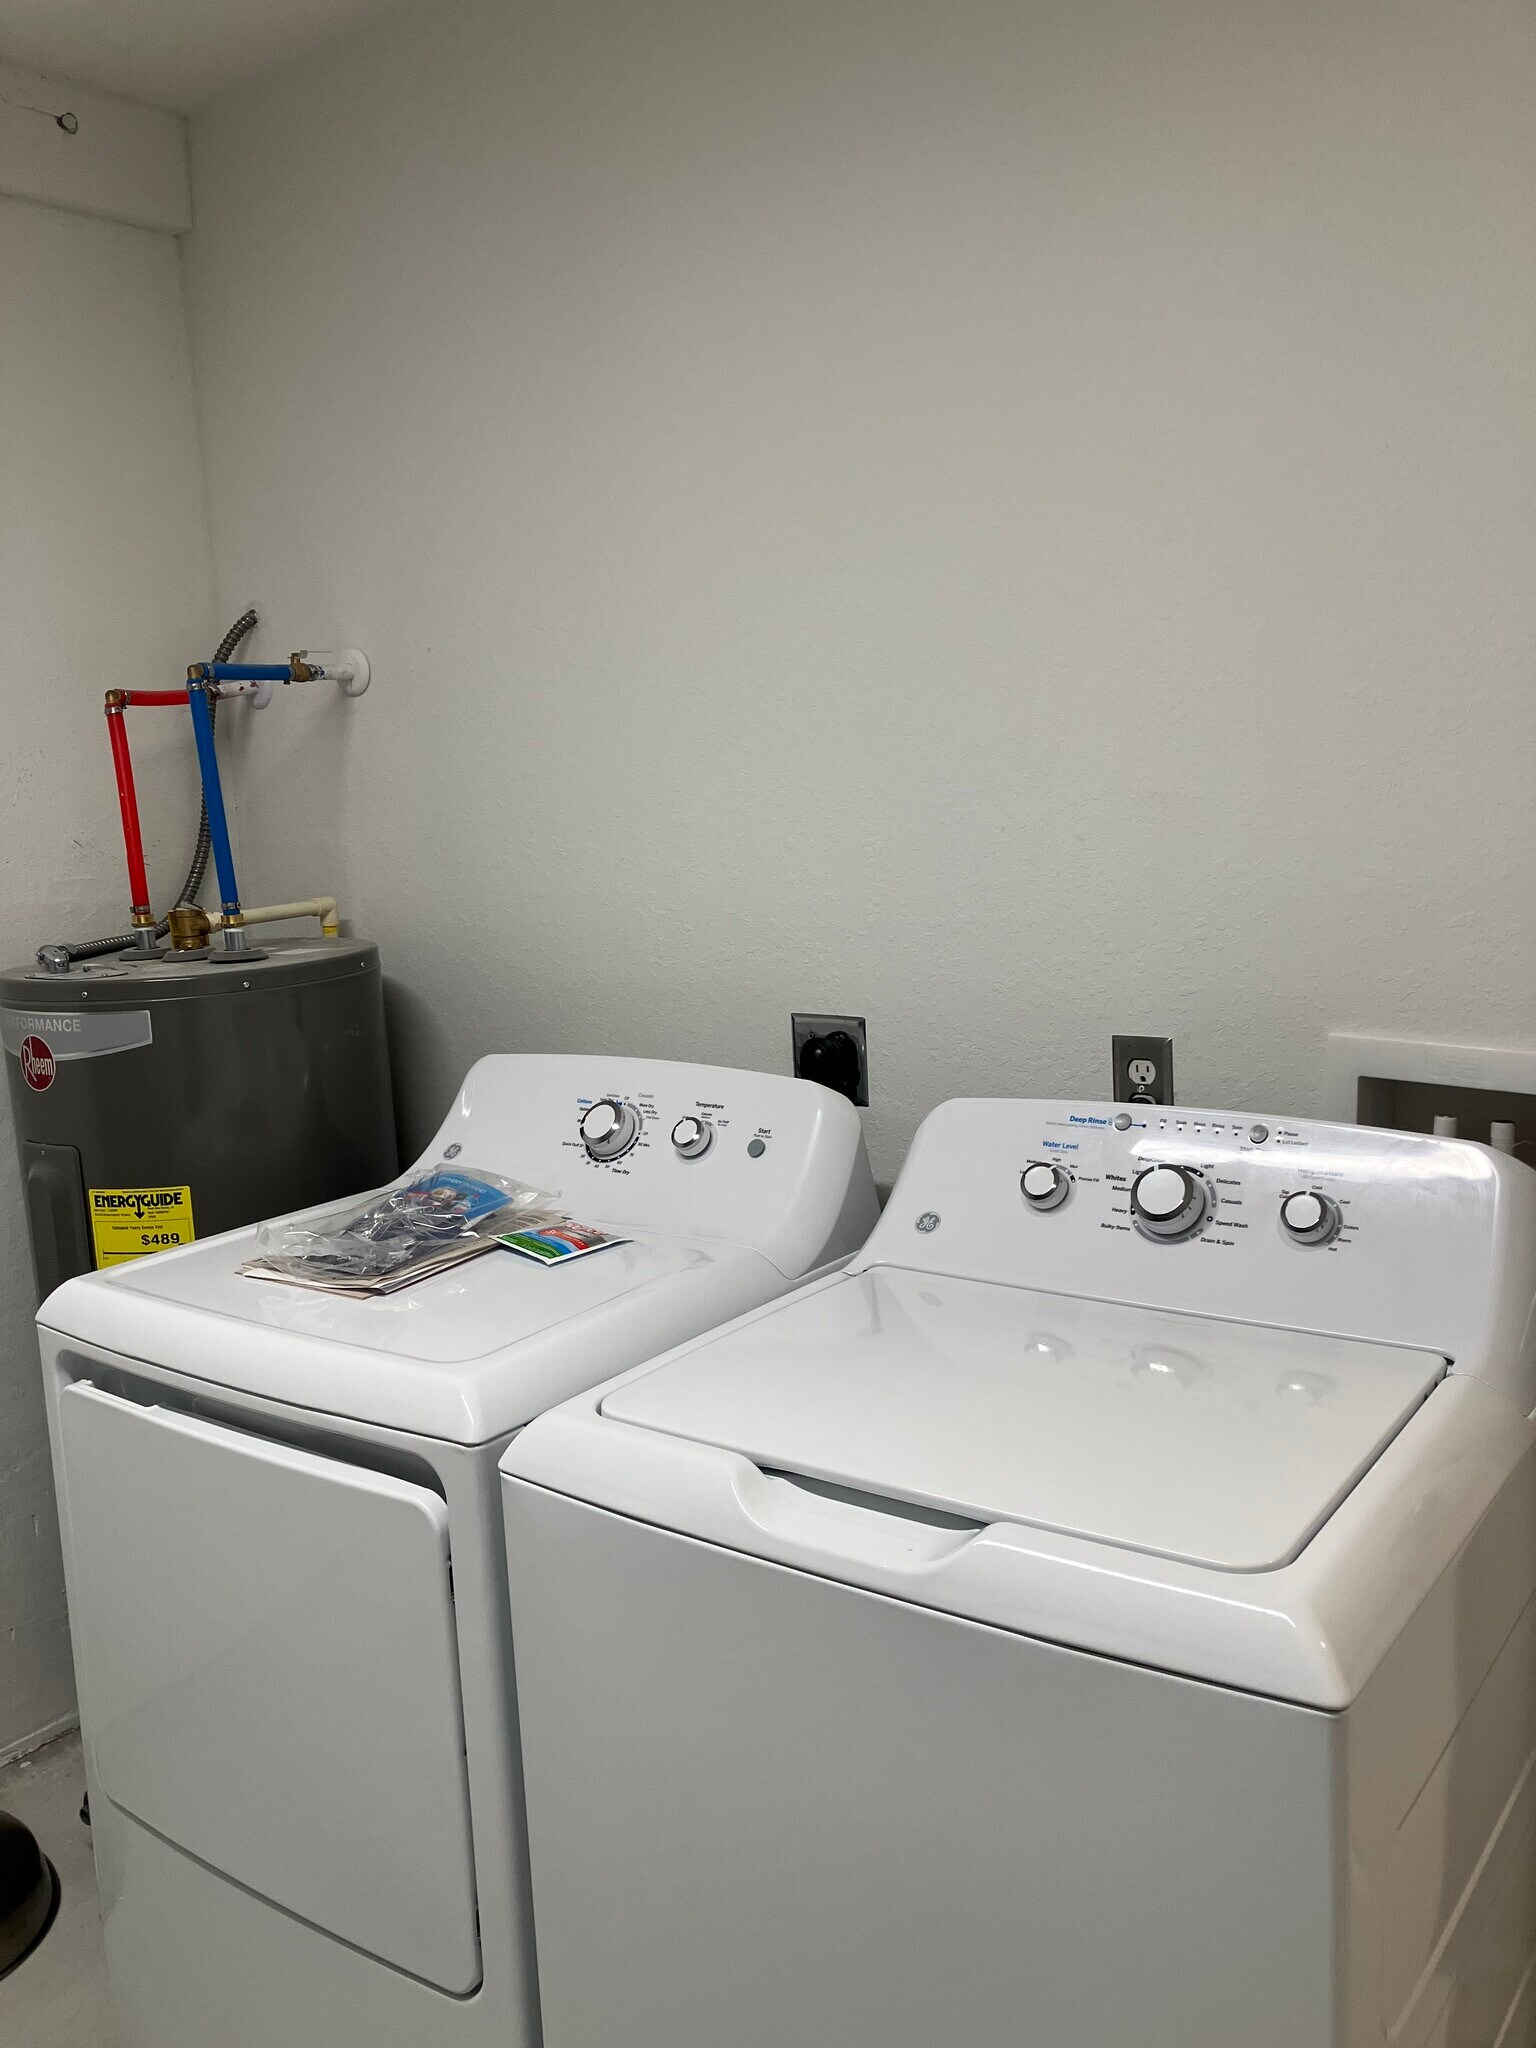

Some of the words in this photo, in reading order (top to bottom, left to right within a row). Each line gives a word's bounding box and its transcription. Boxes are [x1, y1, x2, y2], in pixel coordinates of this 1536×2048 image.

[23, 1037, 54, 1082] Rheem
[696, 1101, 724, 1110] Temperature
[1069, 1115, 1087, 1124] Deep
[1088, 1117, 1107, 1125] Rinse
[1042, 1140, 1061, 1148] Water
[1062, 1142, 1079, 1150] Level
[1105, 1174, 1126, 1182] Whites
[1216, 1178, 1241, 1186] Delicates
[94, 1192, 183, 1209] ENERGYGUIDE
[1220, 1198, 1242, 1206] Casuals
[1100, 1222, 1115, 1230] Bulky
[1115, 1224, 1131, 1232] Items
[1215, 1220, 1232, 1228] Speed
[141, 1233, 180, 1246] $489
[1200, 1237, 1215, 1245] Drain
[1221, 1239, 1235, 1247] Spin
